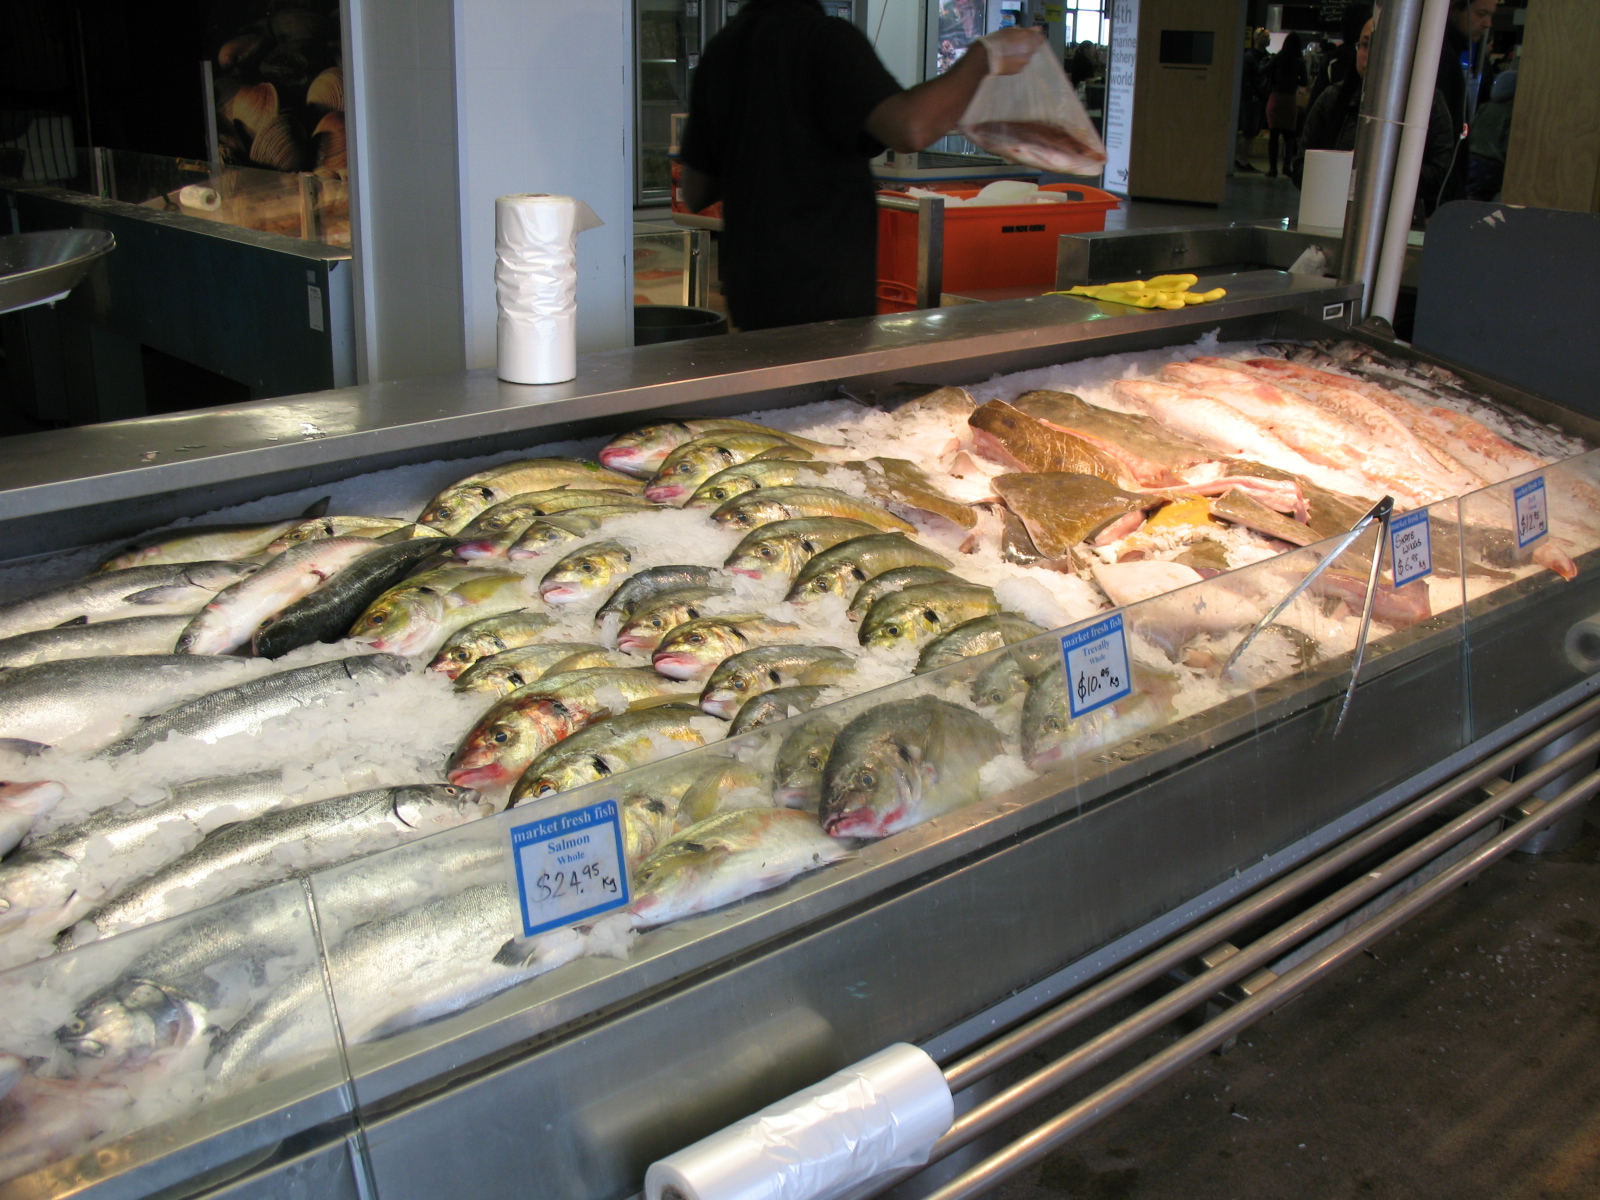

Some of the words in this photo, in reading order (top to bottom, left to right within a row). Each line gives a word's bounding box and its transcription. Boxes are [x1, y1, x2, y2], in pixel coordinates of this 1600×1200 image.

[1113, 36, 1137, 48] marine
[1063, 631, 1090, 649] market
[1090, 623, 1109, 638] fresh
[1109, 617, 1122, 630] fish
[1082, 639, 1110, 657] Trevally
[513, 820, 559, 844] market
[560, 812, 592, 830] fresh
[594, 804, 616, 820] fish
[547, 834, 591, 855] Salmon
[557, 851, 585, 866] Whole
